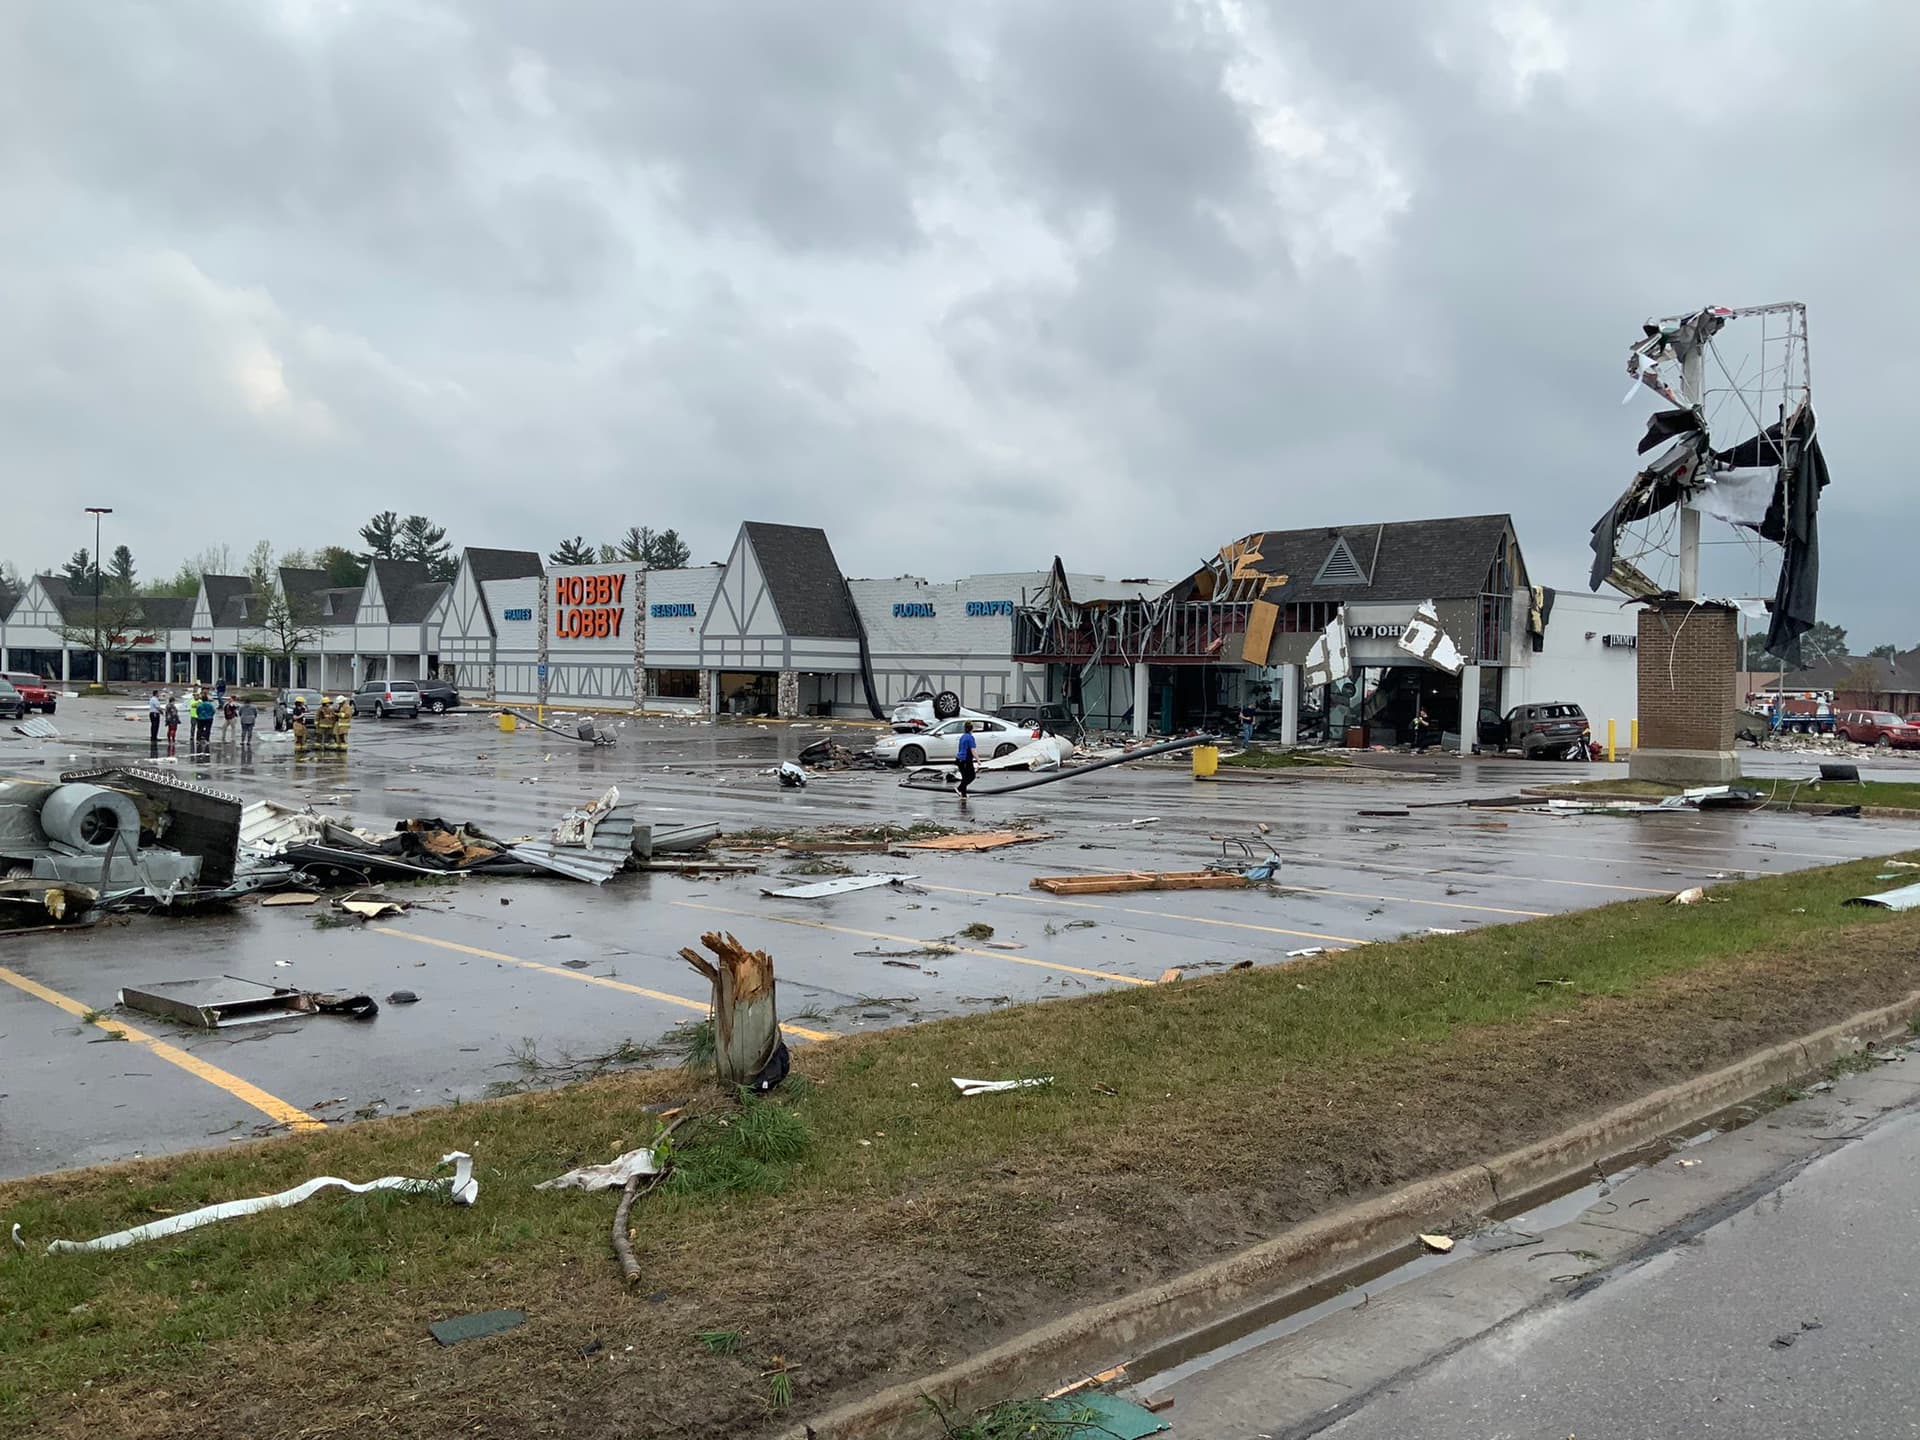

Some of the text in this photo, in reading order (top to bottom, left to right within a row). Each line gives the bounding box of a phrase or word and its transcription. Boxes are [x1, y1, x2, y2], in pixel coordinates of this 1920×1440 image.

[556, 574, 626, 606] HOBBY
[504, 608, 531, 620] FRAMES
[650, 603, 696, 617] SEASONAL
[893, 602, 936, 617] FLORAL
[966, 600, 1014, 616] CRAFTS
[556, 607, 625, 638] LOBBY
